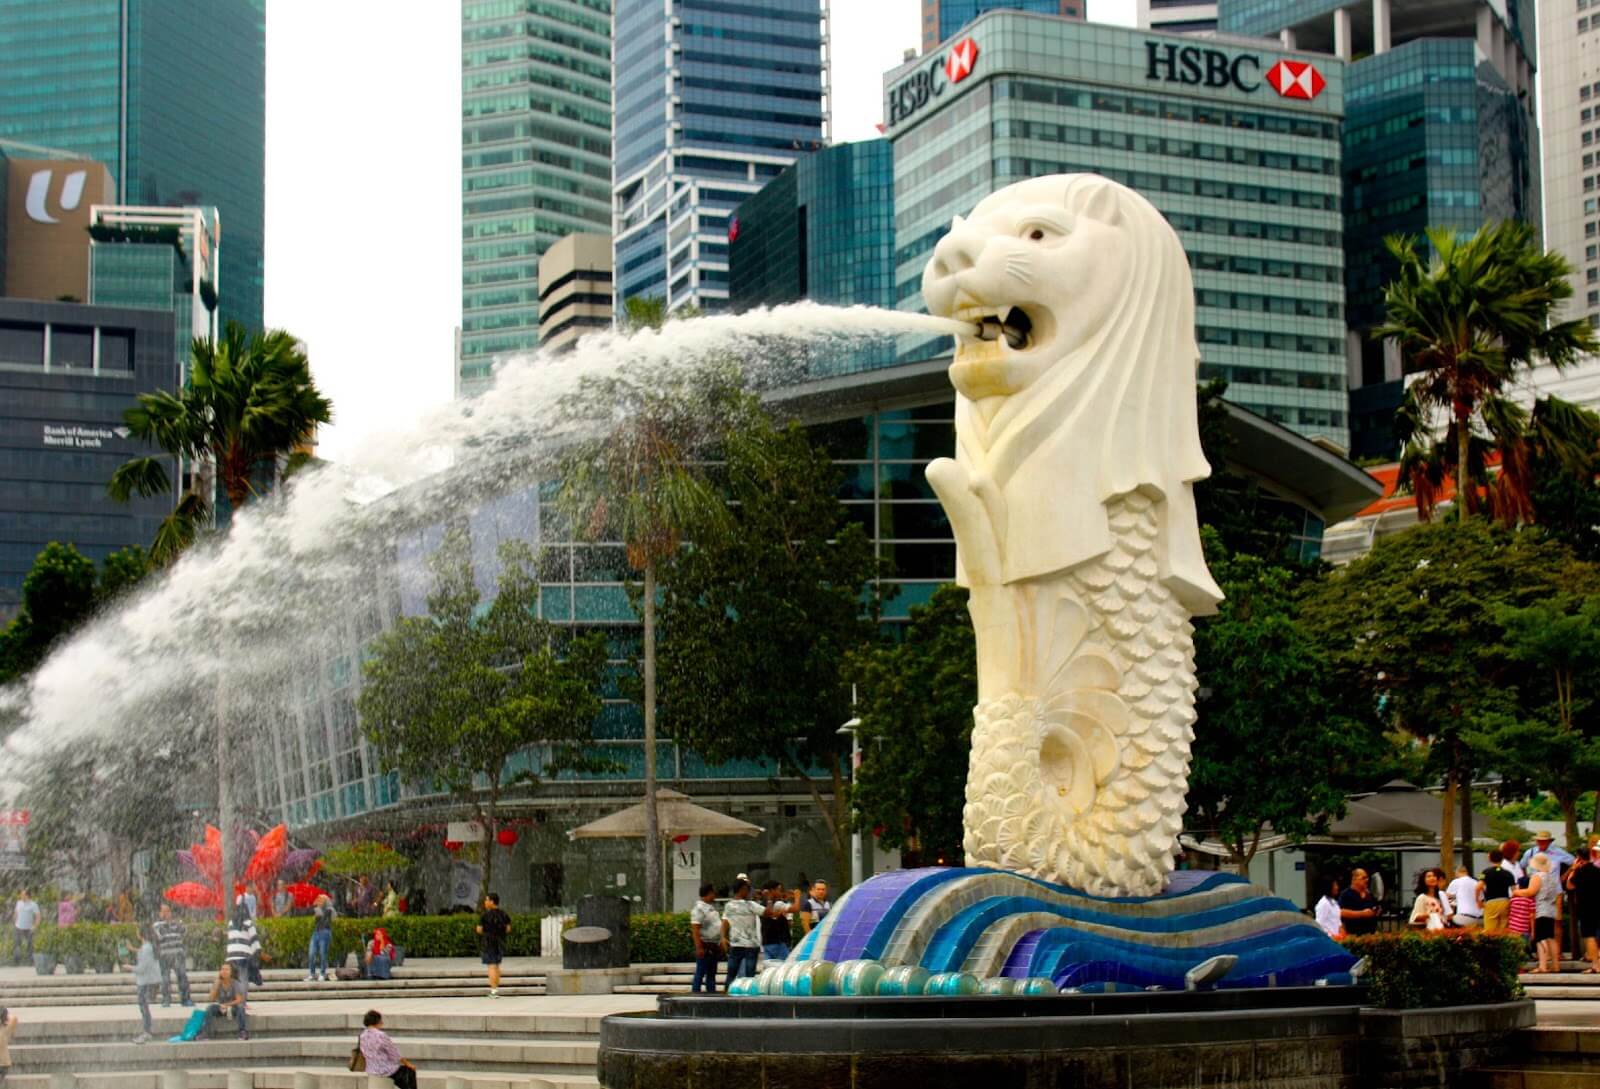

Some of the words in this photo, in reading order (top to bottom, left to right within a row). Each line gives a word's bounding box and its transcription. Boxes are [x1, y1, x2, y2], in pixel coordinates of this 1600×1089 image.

[1145, 41, 1261, 93] HSBC
[888, 56, 946, 127] HSBC
[44, 425, 66, 436] Bank
[76, 427, 113, 439] America
[44, 435, 74, 446] Merrill
[75, 437, 102, 448] Lynch
